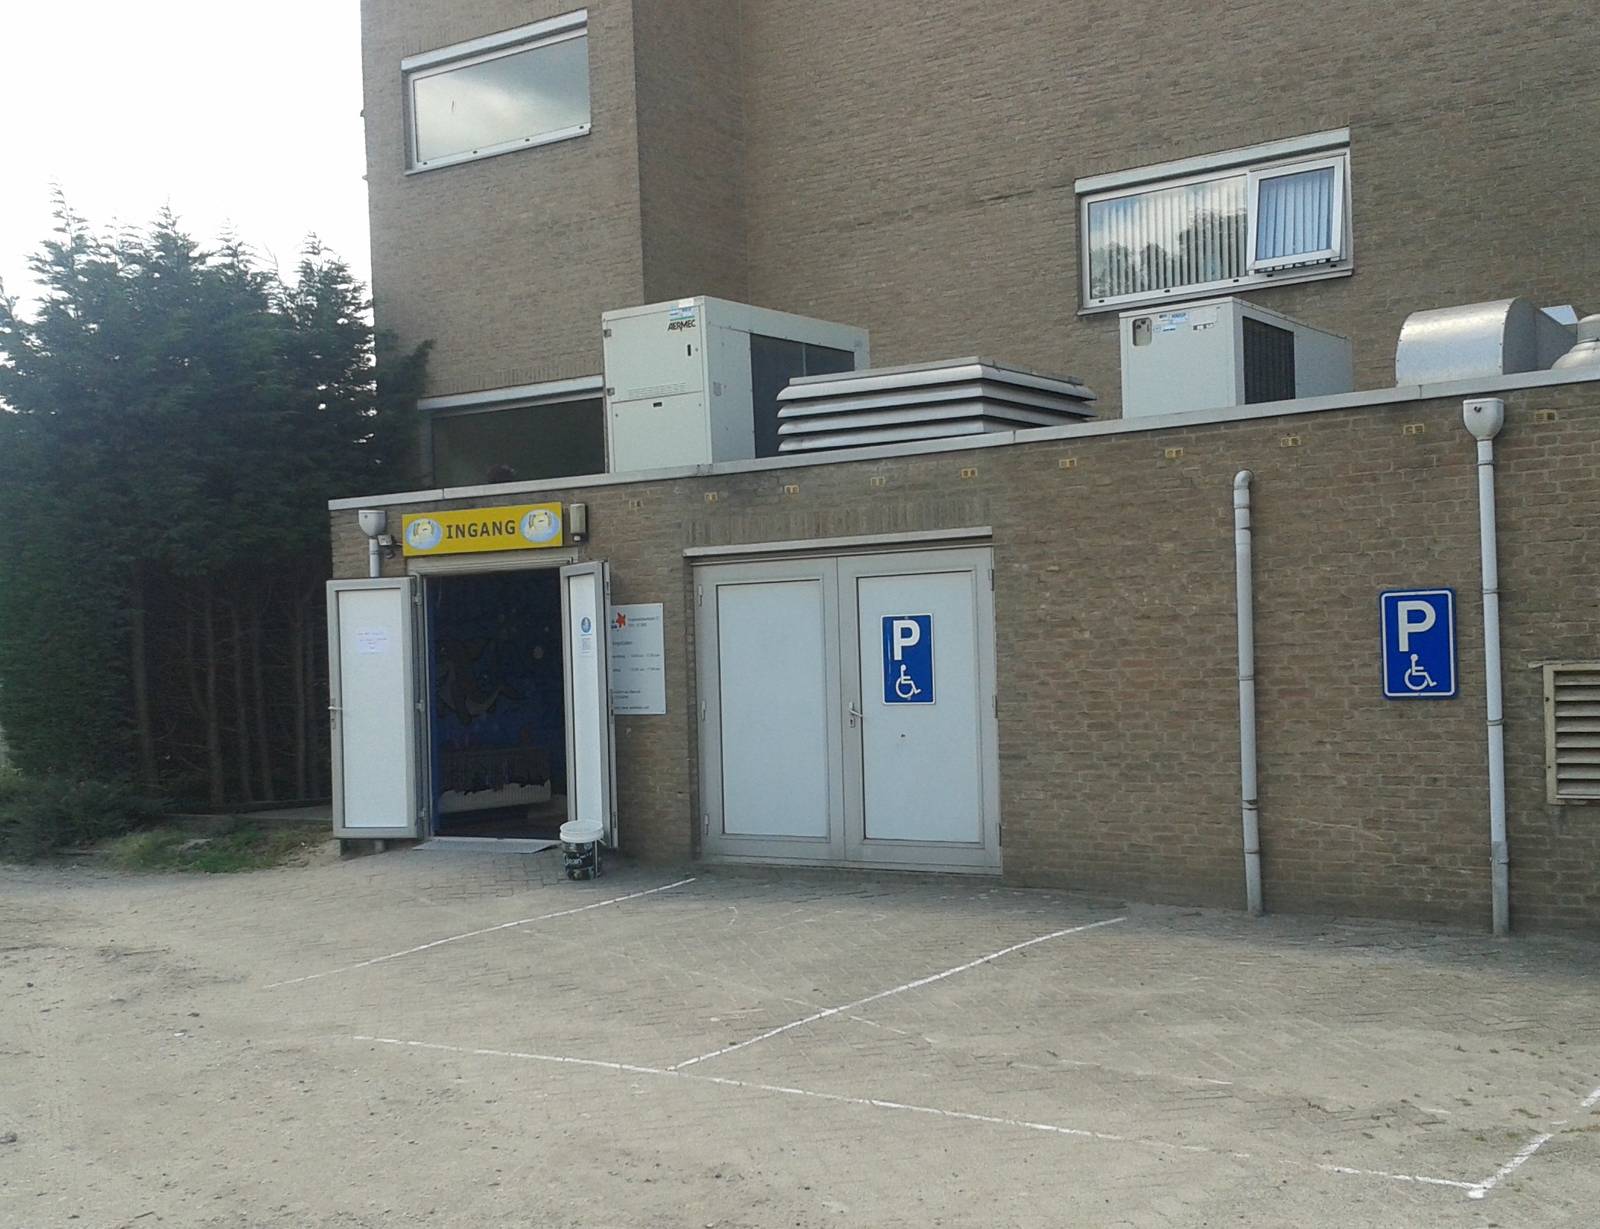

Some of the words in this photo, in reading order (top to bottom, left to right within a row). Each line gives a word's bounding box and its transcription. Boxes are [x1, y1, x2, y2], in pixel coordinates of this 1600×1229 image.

[667, 320, 696, 332] AERMEC
[446, 520, 516, 539] INGANG
[893, 620, 920, 660] P
[1397, 600, 1436, 652] P
